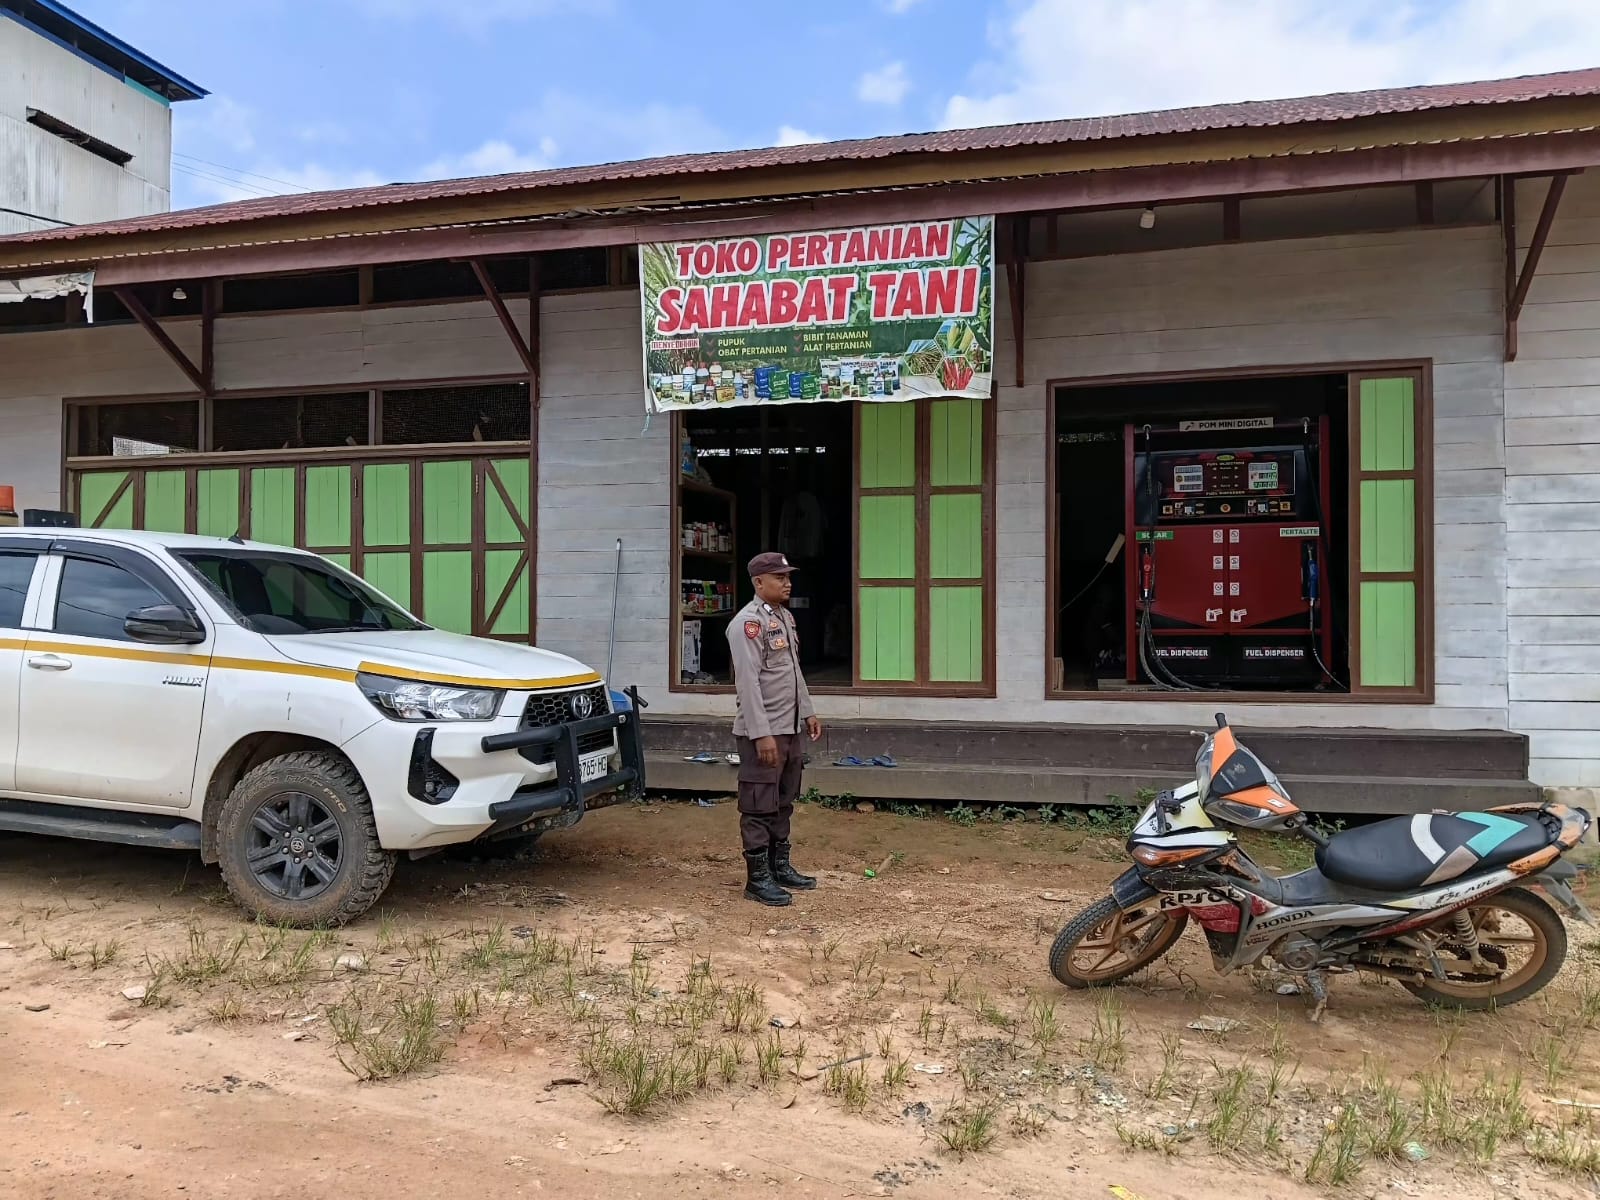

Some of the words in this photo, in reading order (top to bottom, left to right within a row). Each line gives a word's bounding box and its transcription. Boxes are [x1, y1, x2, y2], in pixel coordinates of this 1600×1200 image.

[676, 240, 758, 278] TOKO
[766, 223, 950, 270] PERTANIAN
[656, 275, 855, 333] SAHABAT
[868, 267, 977, 319] TANI
[803, 332, 824, 342] BIBIT
[825, 330, 869, 341] TANAMAN
[717, 338, 745, 347] PUPUK
[803, 343, 823, 352] ALAT
[825, 340, 872, 351] PERTANIAN
[717, 348, 740, 357] OBAT
[741, 345, 787, 355] PERTANIAN
[1218, 420, 1236, 429] MINI
[1237, 419, 1269, 428] DIGITAL
[1141, 531, 1168, 540] SOAR
[1280, 527, 1319, 536] PERTALITE
[1153, 649, 1169, 657] UEL
[1170, 649, 1209, 657] DISPENSER
[1245, 649, 1263, 657] FUEL
[1264, 649, 1304, 657] DISPENSER
[323, 787, 348, 814] PRO
[1256, 909, 1316, 931] HONDA
